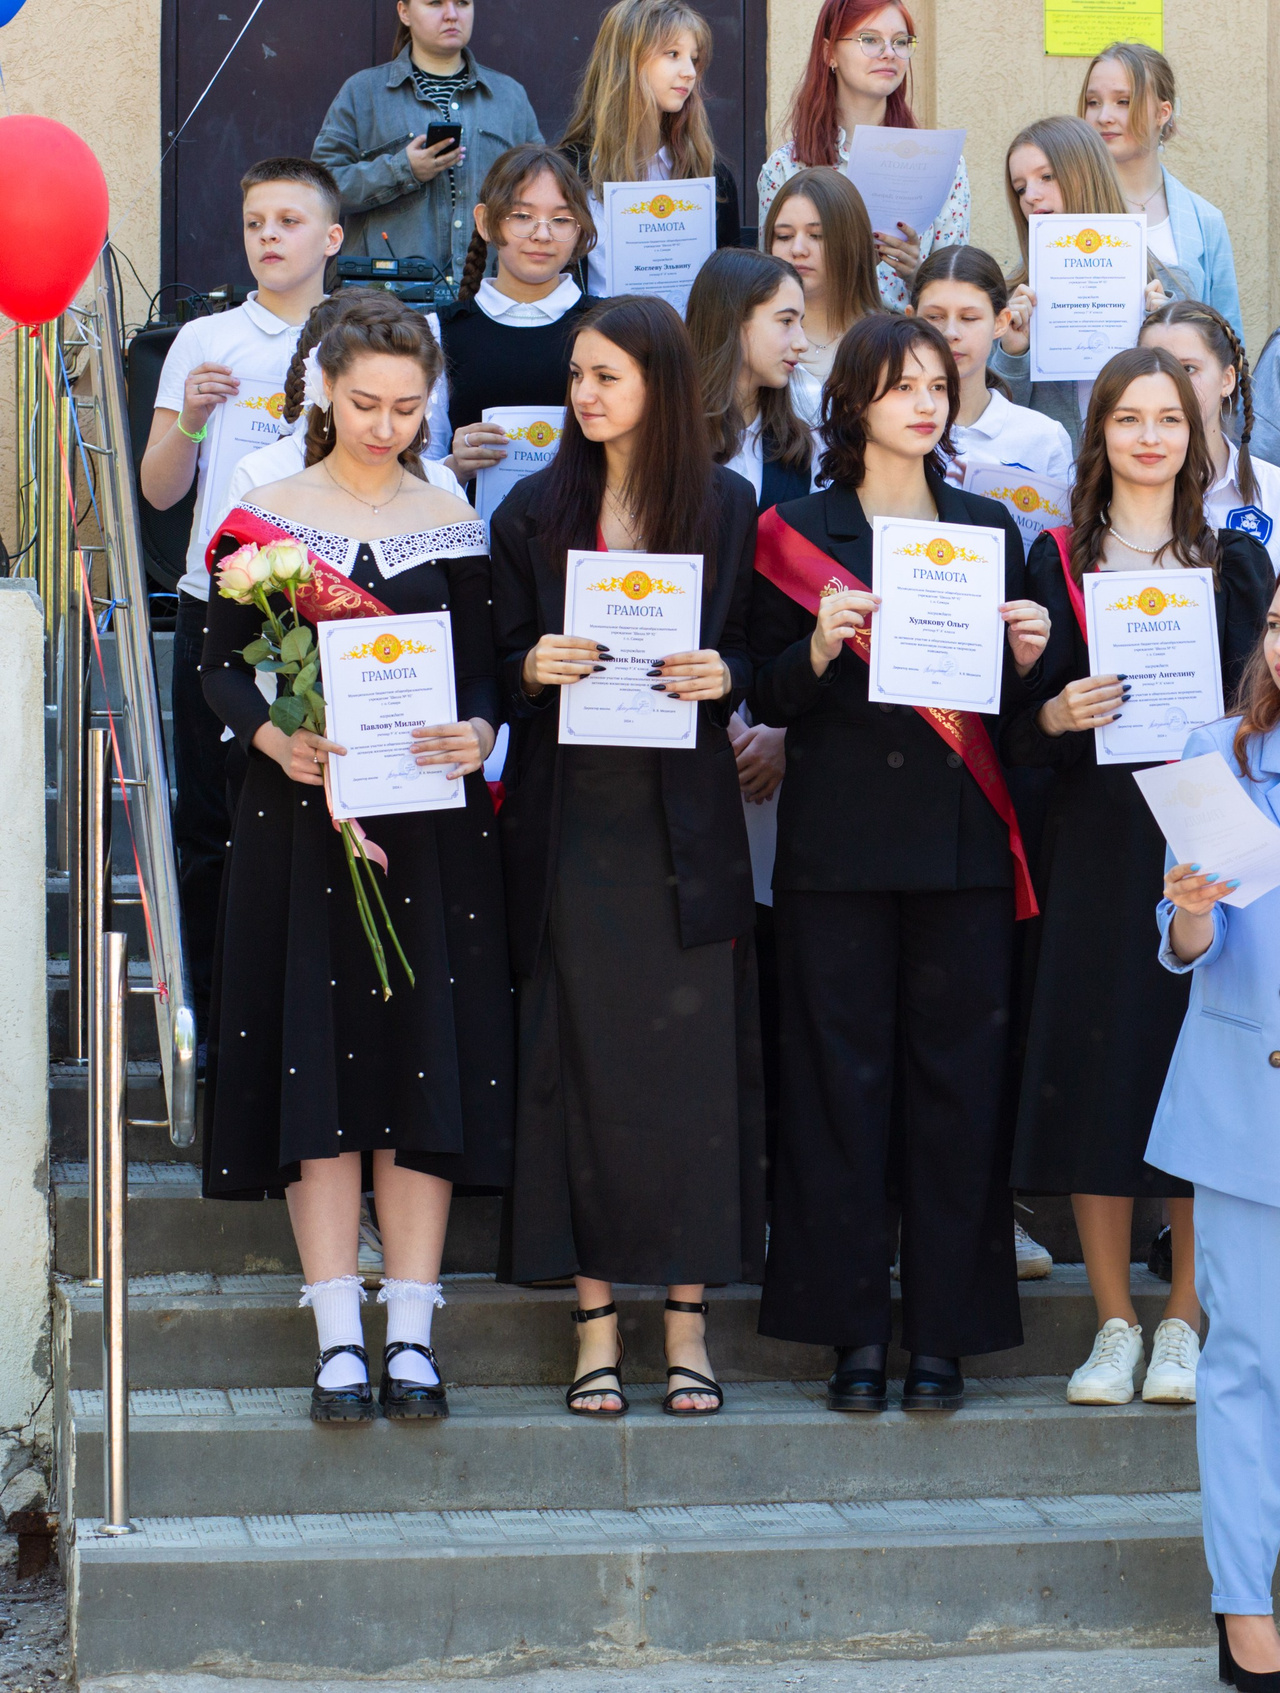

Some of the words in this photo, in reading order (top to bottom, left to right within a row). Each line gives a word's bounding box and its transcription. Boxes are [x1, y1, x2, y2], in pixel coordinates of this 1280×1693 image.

[639, 222, 685, 233] ГРАМОТА
[1064, 258, 1113, 268] ГРАМОТА
[1051, 302, 1090, 310] Дмитриеву
[251, 420, 280, 434] ГРАМ
[913, 568, 968, 583] ГРАМОТА
[607, 604, 663, 617] ГРАМОТА
[909, 616, 945, 628] Худякову
[947, 620, 970, 630] Ольгу
[1127, 620, 1181, 633] ГРАМОТА
[362, 667, 417, 682] ГРАМОТА
[1159, 671, 1196, 679] Ангелину
[360, 722, 393, 733] Павлову
[394, 719, 427, 730] Милану
